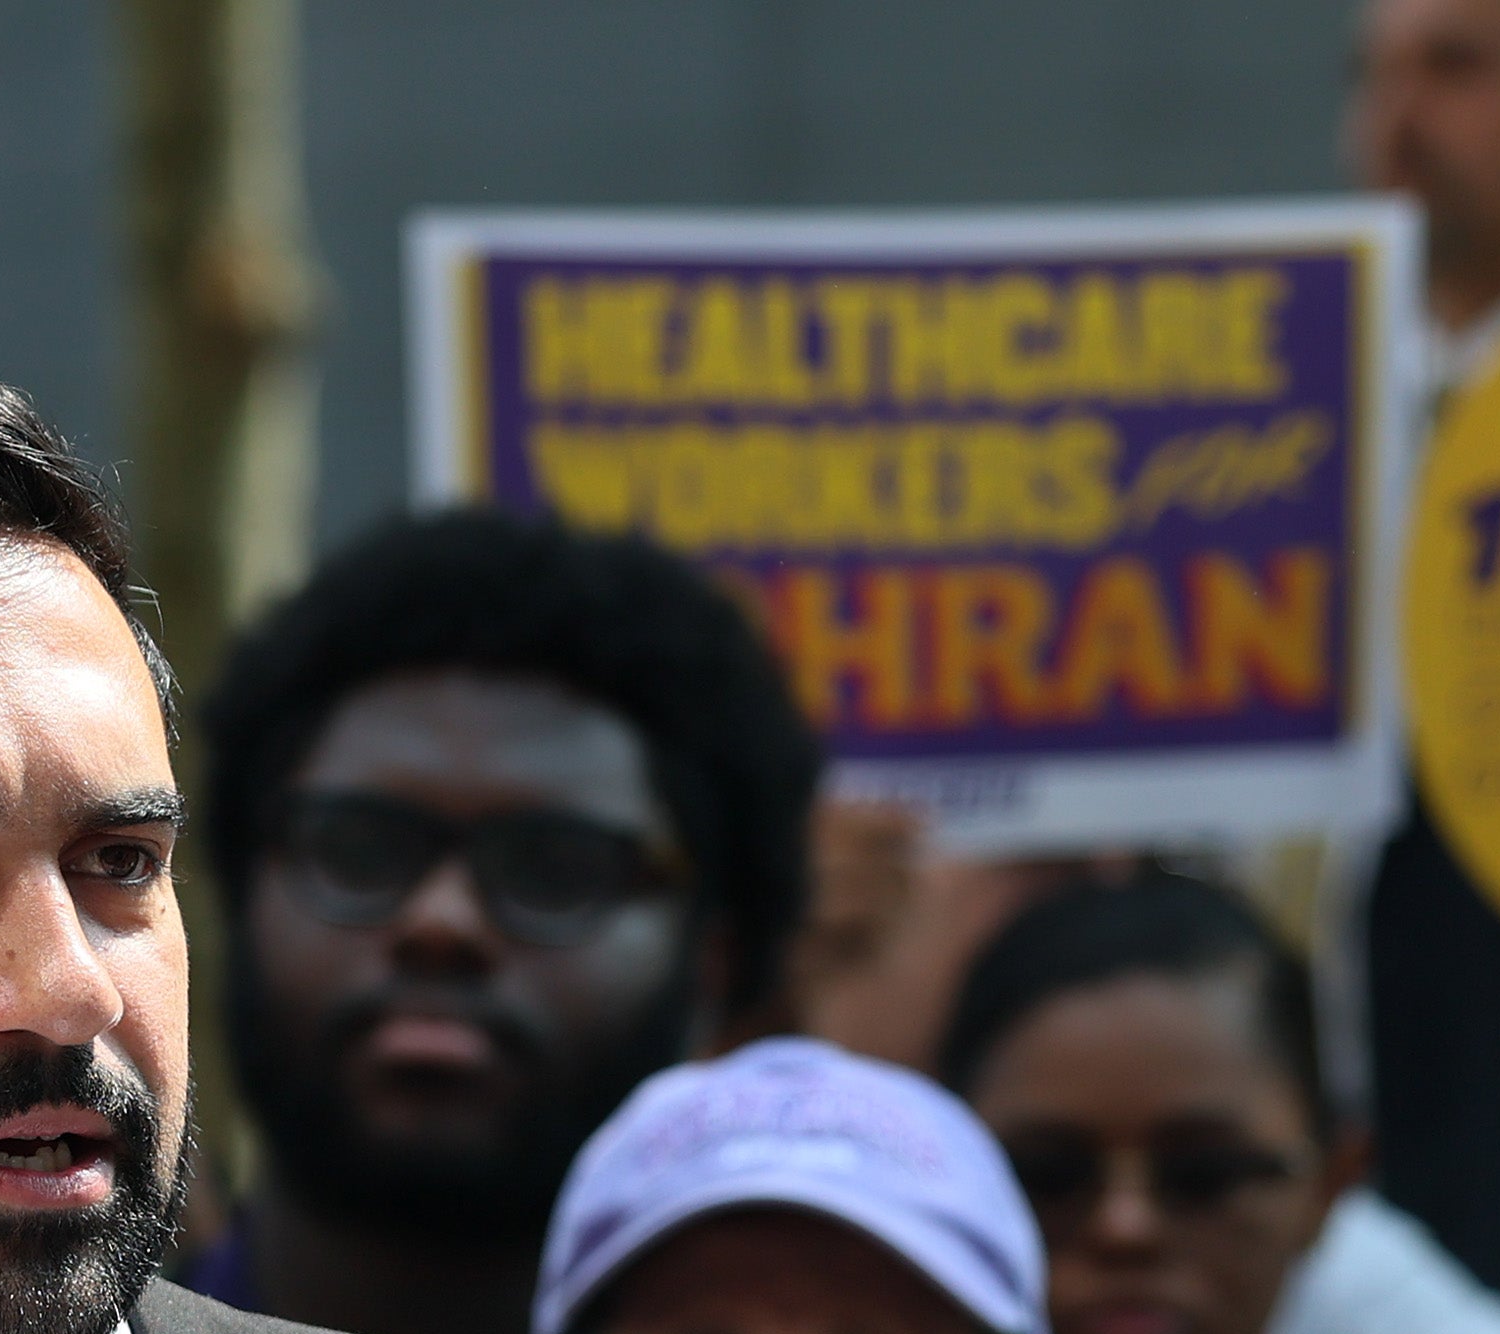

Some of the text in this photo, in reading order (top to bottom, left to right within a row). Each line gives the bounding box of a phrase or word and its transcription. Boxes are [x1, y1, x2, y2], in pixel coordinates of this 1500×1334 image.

[524, 270, 1290, 408] HEALTHCARE
[530, 415, 1122, 550] WORKERS
[745, 552, 1330, 732] HRAN
